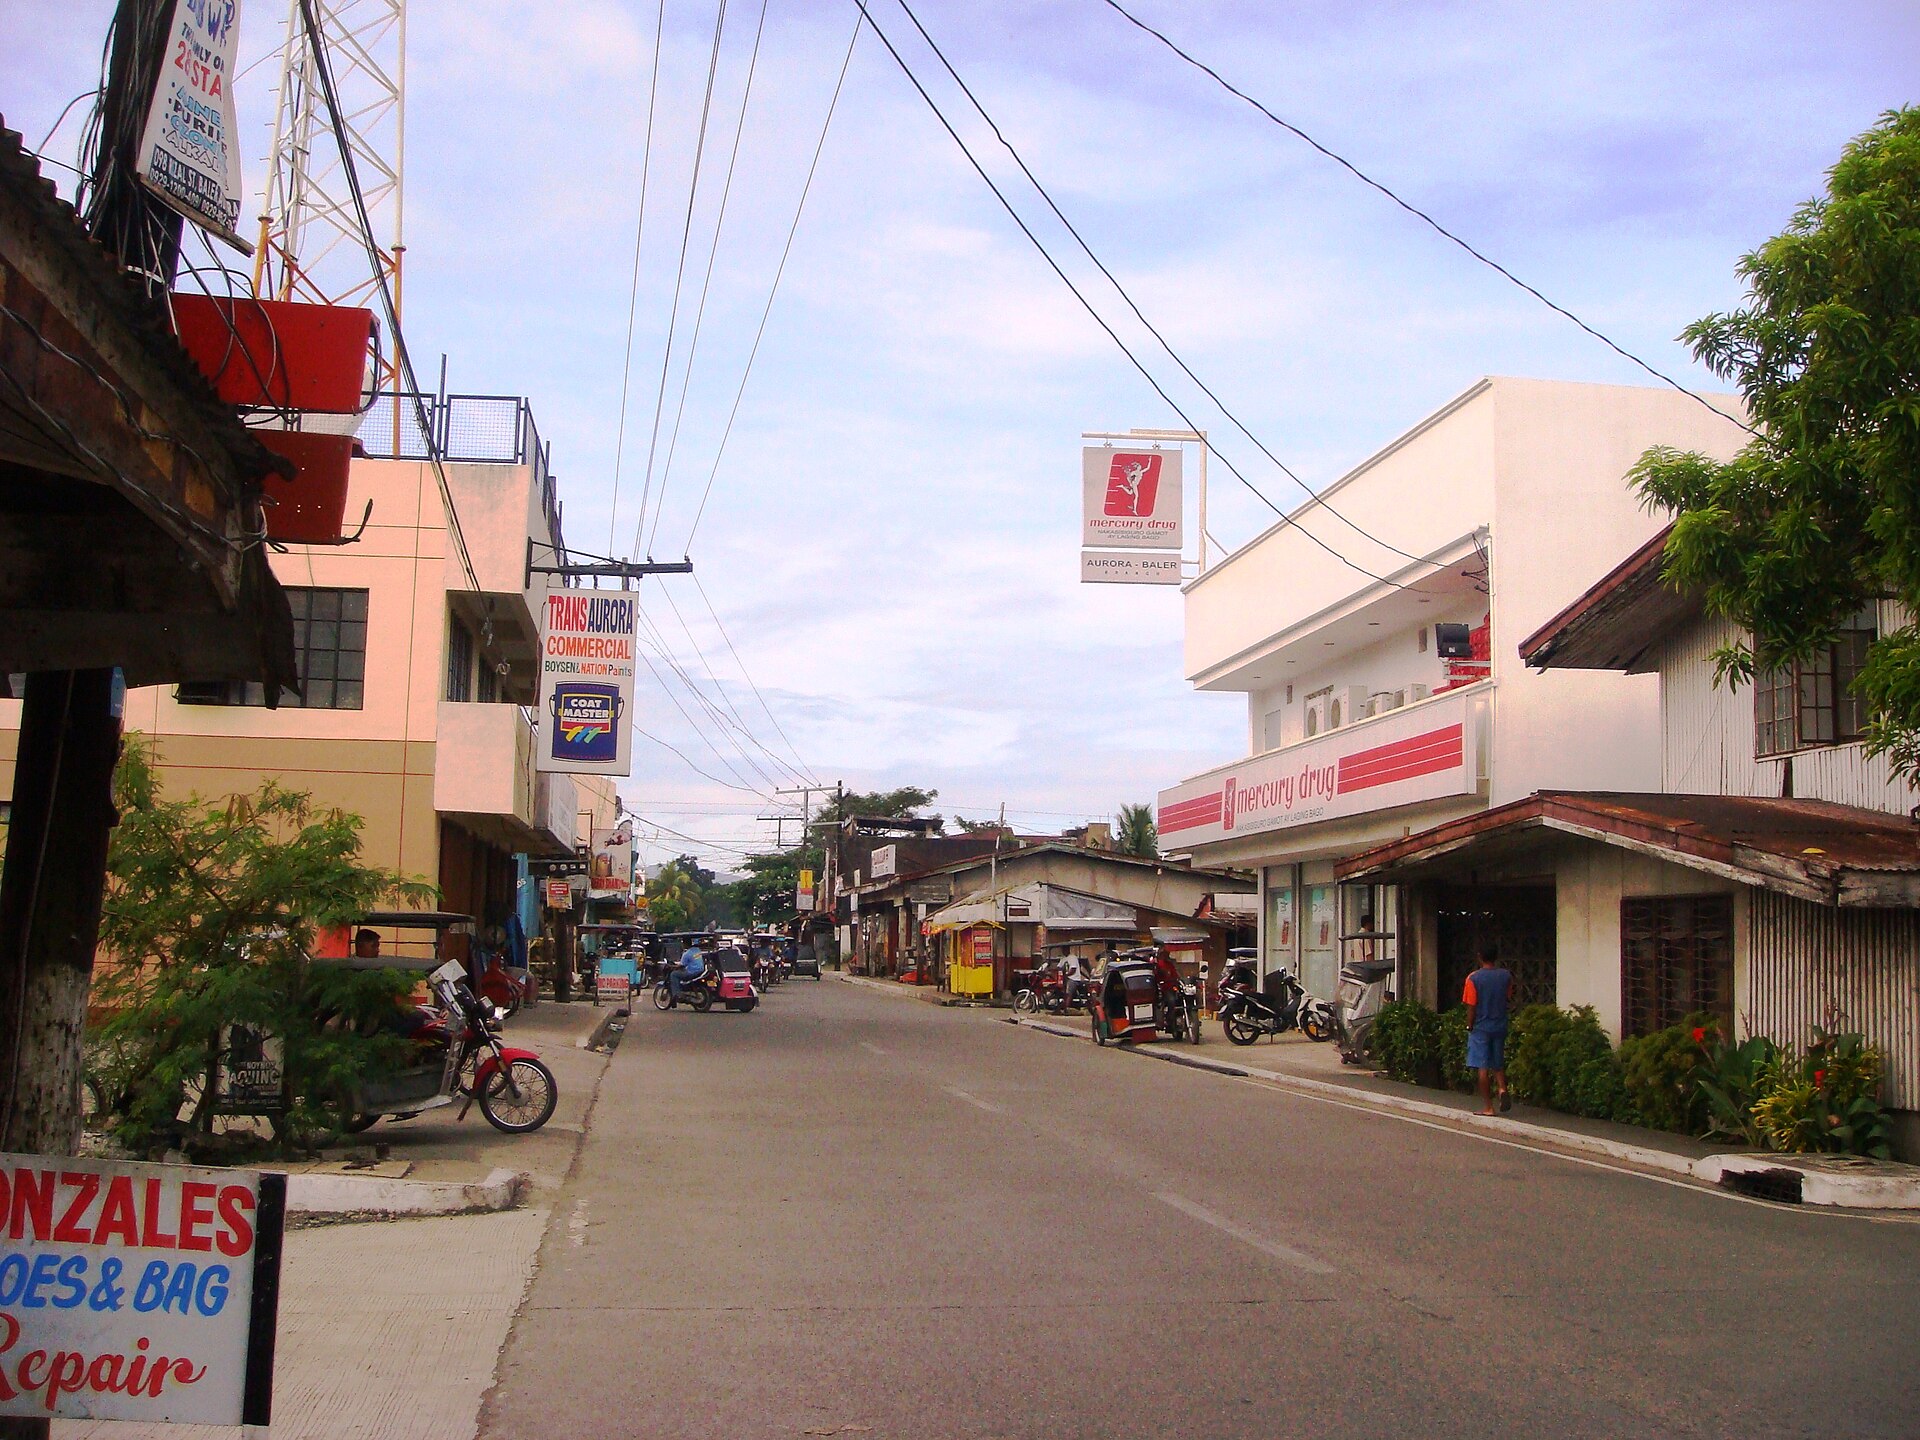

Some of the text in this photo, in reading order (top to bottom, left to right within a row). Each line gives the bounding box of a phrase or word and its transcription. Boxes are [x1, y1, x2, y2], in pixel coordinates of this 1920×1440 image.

[1090, 520, 1176, 530] mercury drug
[1087, 560, 1132, 568] AURORA
[1142, 561, 1177, 569] BALER
[548, 595, 633, 634] TRANS AURORA
[547, 635, 631, 660] COMMERCIAL
[545, 660, 575, 673] BOYSEN
[581, 663, 607, 675] NATION
[608, 664, 632, 677] Paints
[570, 698, 602, 708] COAT
[563, 708, 609, 718] MASTER
[1237, 764, 1335, 815] mercury drug
[133, 1260, 230, 1317] BAG
